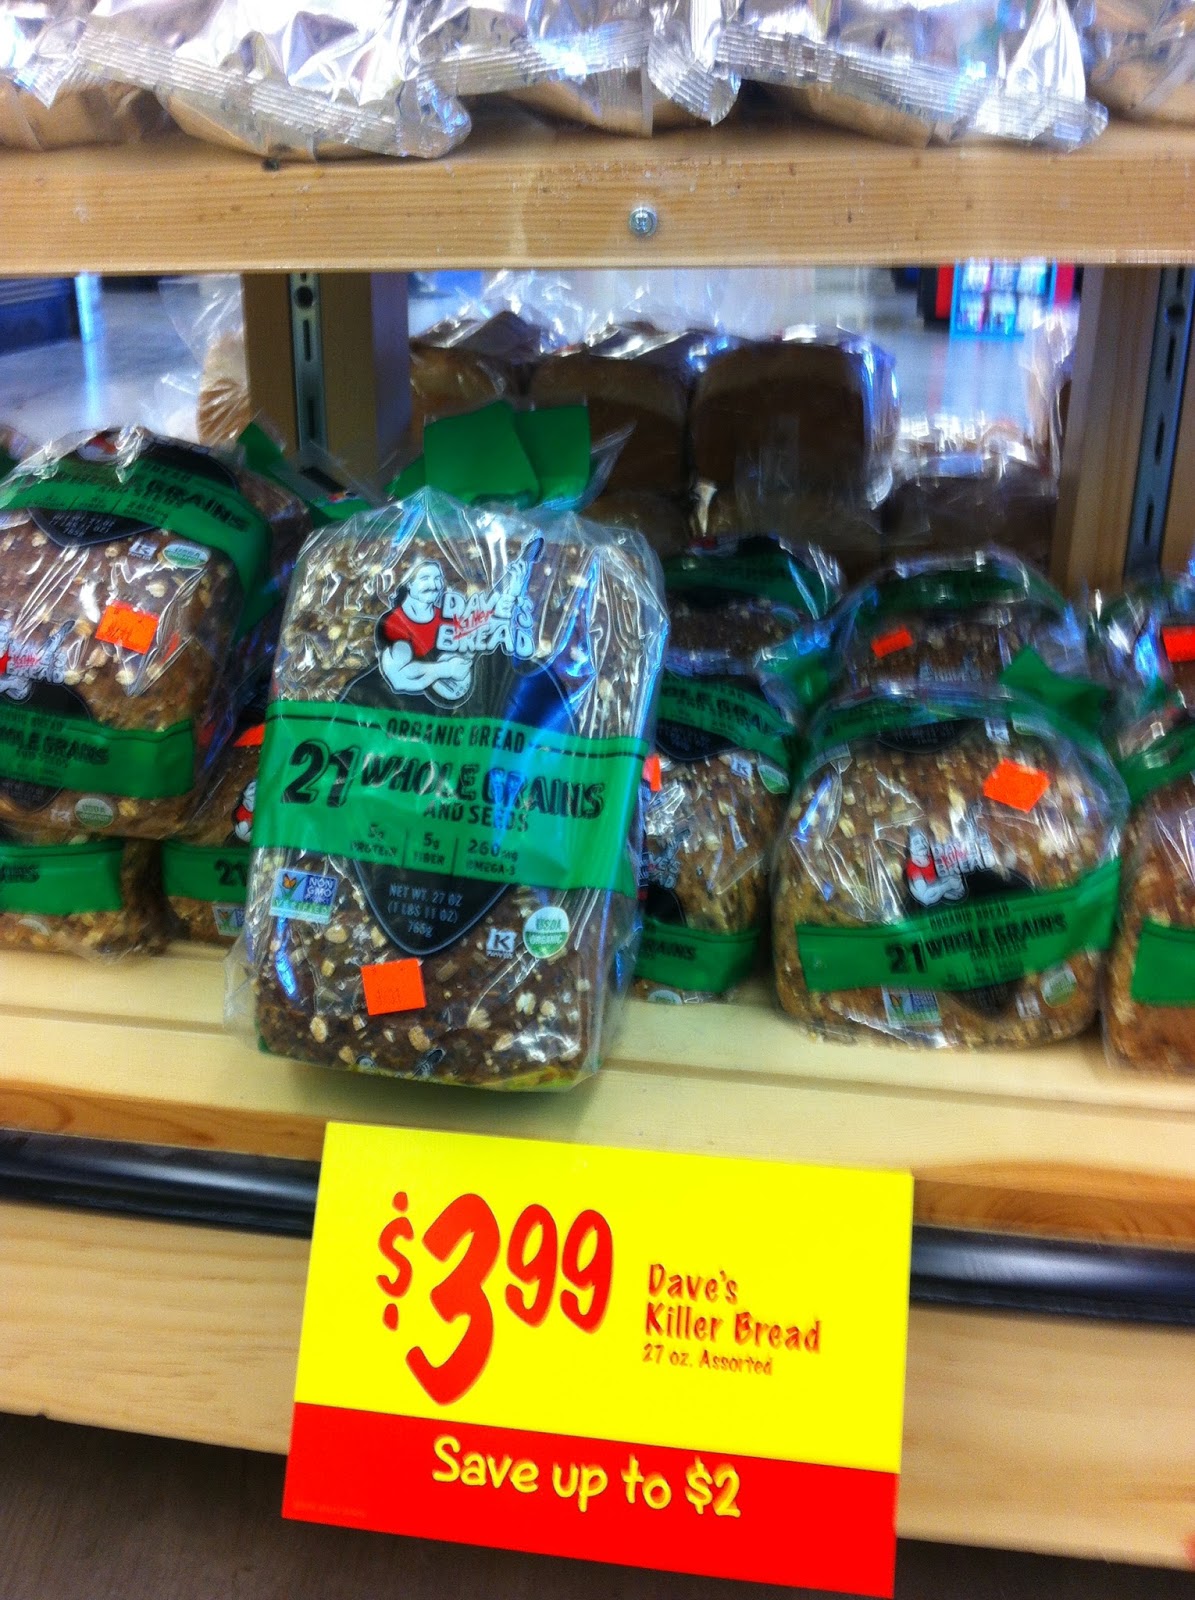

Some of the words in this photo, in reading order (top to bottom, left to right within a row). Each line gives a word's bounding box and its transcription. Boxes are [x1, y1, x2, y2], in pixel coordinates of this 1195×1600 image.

[442, 592, 534, 629] DAVE'S
[436, 622, 534, 658] BREAD
[386, 718, 464, 747] ORGANIC
[468, 726, 525, 753] BREAD
[281, 738, 361, 808] 21
[361, 752, 480, 801] WHOLE
[481, 767, 605, 819] GRAINS
[423, 801, 464, 822] AND
[467, 805, 529, 832] SEEDS
[423, 832, 440, 850] 5g
[414, 851, 445, 866] FIBER
[466, 860, 516, 876] OMEGA-3
[307, 886, 333, 898] GMO
[309, 876, 334, 889] NON
[389, 883, 410, 898] NET
[412, 886, 428, 901] WT
[432, 890, 446, 905] 27
[448, 892, 464, 907] OZ
[492, 934, 511, 950] K
[885, 934, 927, 974] 21
[648, 1263, 738, 1305] Dave's
[645, 1302, 724, 1343] Killer
[734, 1311, 820, 1354] Bread
[643, 1343, 664, 1364] 27
[669, 1351, 692, 1367] oz.
[701, 1349, 772, 1376] Assorted
[432, 1434, 539, 1493] Save
[552, 1463, 609, 1513] up
[621, 1454, 671, 1510] to
[684, 1455, 741, 1518] $2
